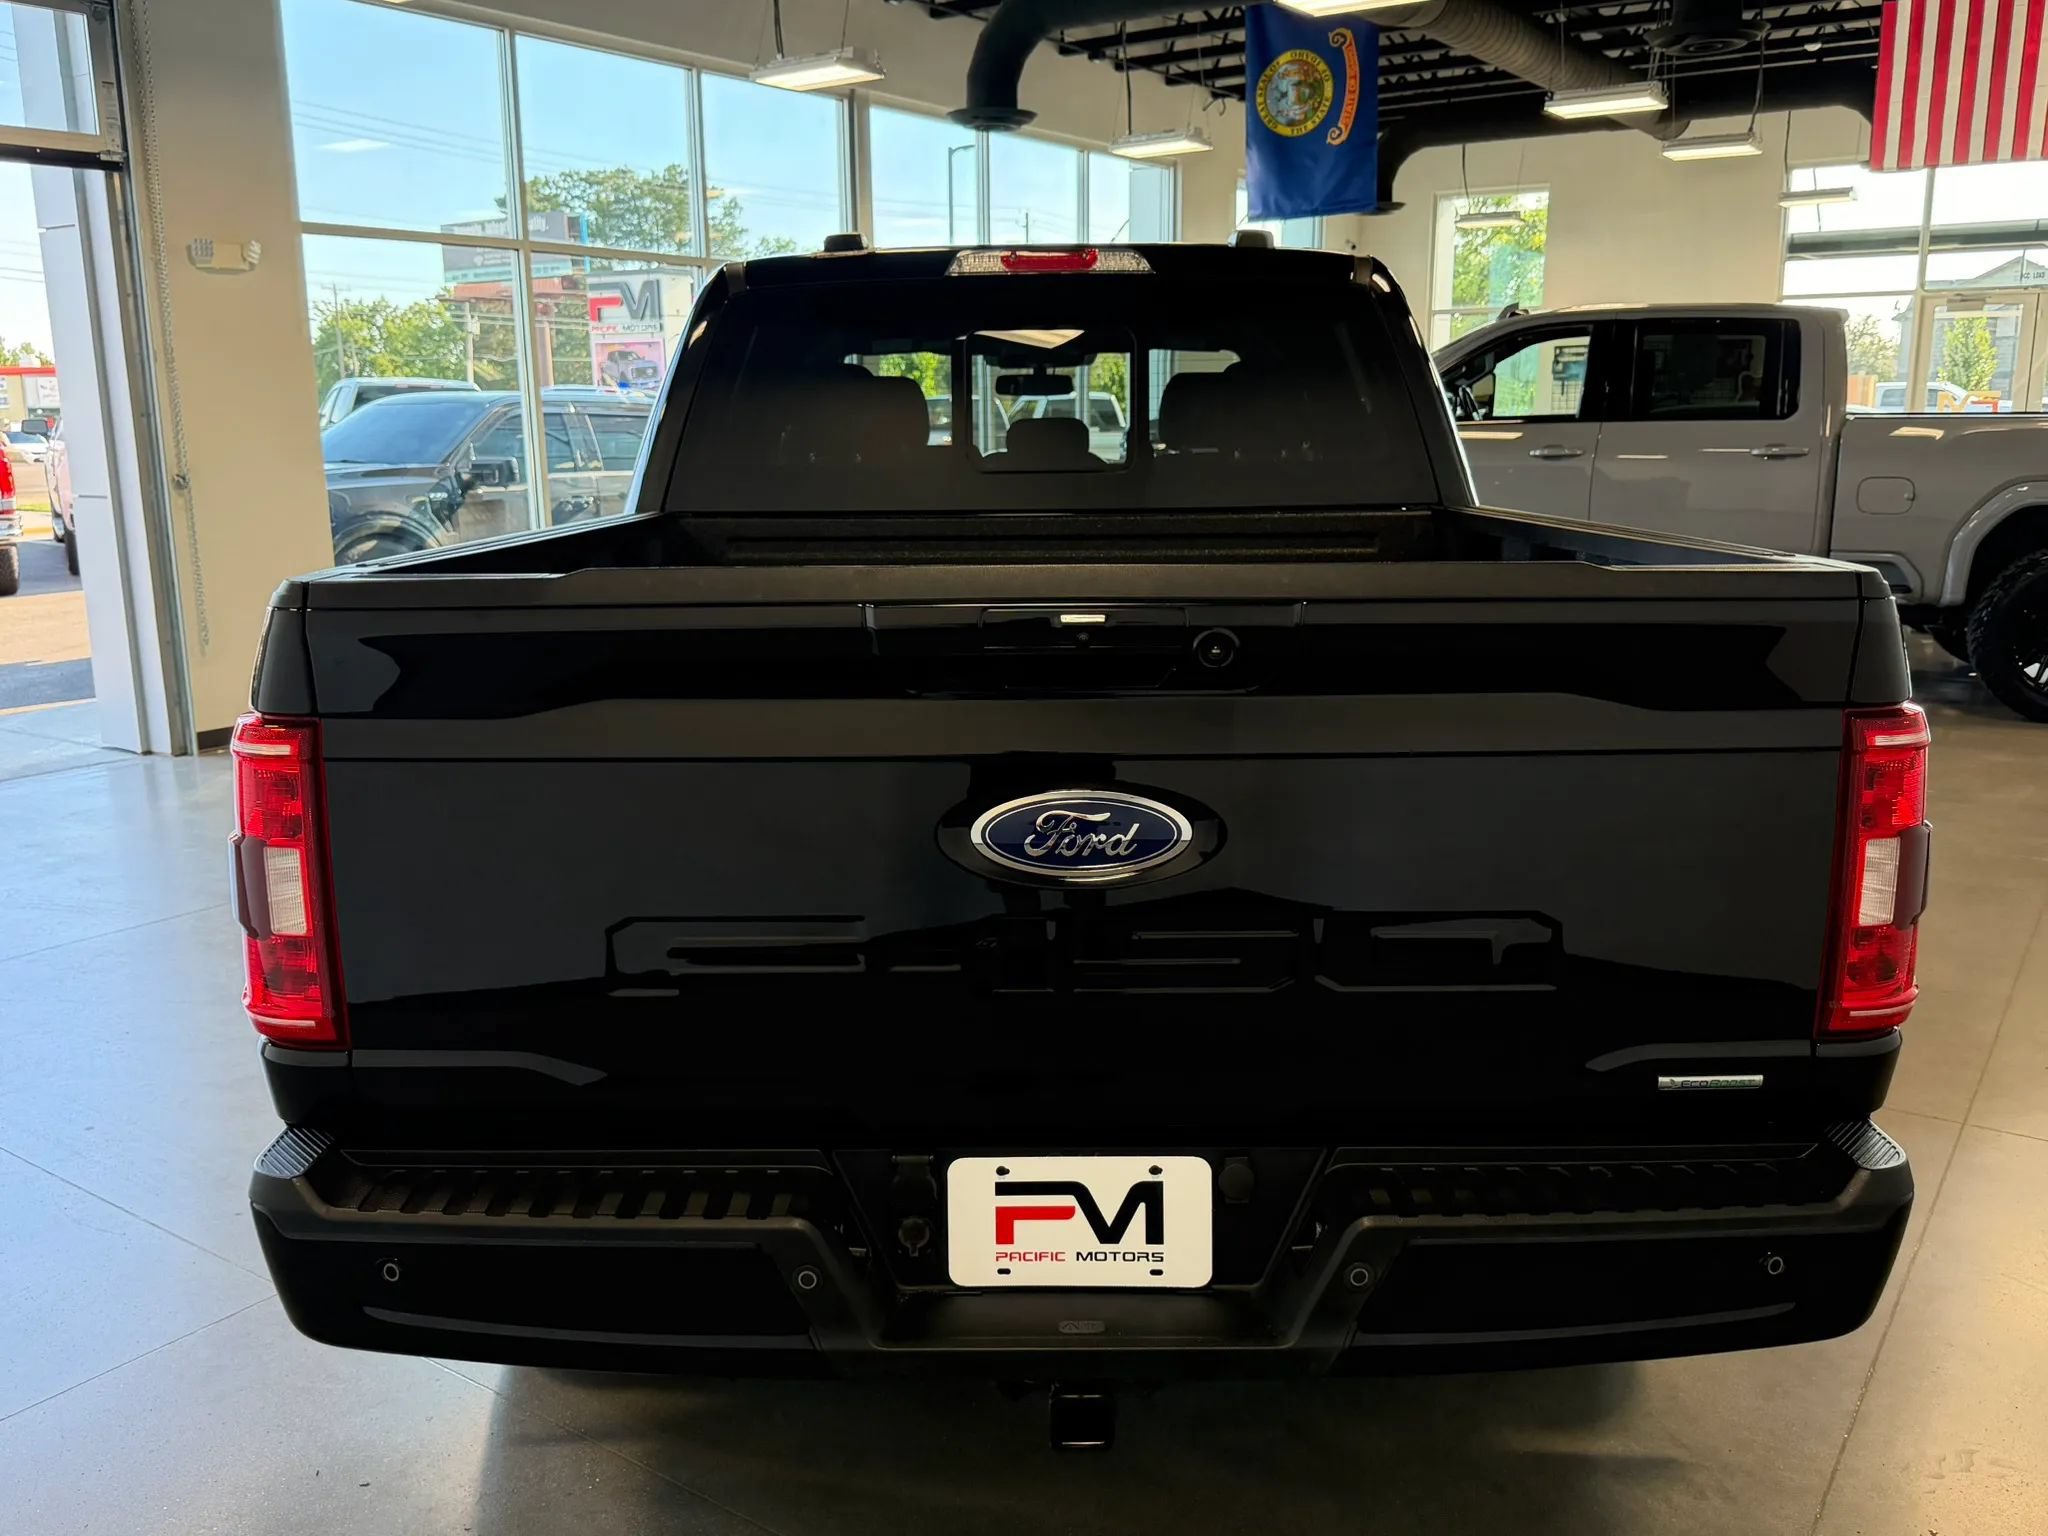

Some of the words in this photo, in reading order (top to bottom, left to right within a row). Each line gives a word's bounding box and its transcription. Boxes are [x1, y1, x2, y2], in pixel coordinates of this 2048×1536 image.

[1023, 809, 1140, 857] Ford
[995, 1251, 1067, 1263] PACIFIC
[1075, 1251, 1165, 1263] MOTORS
